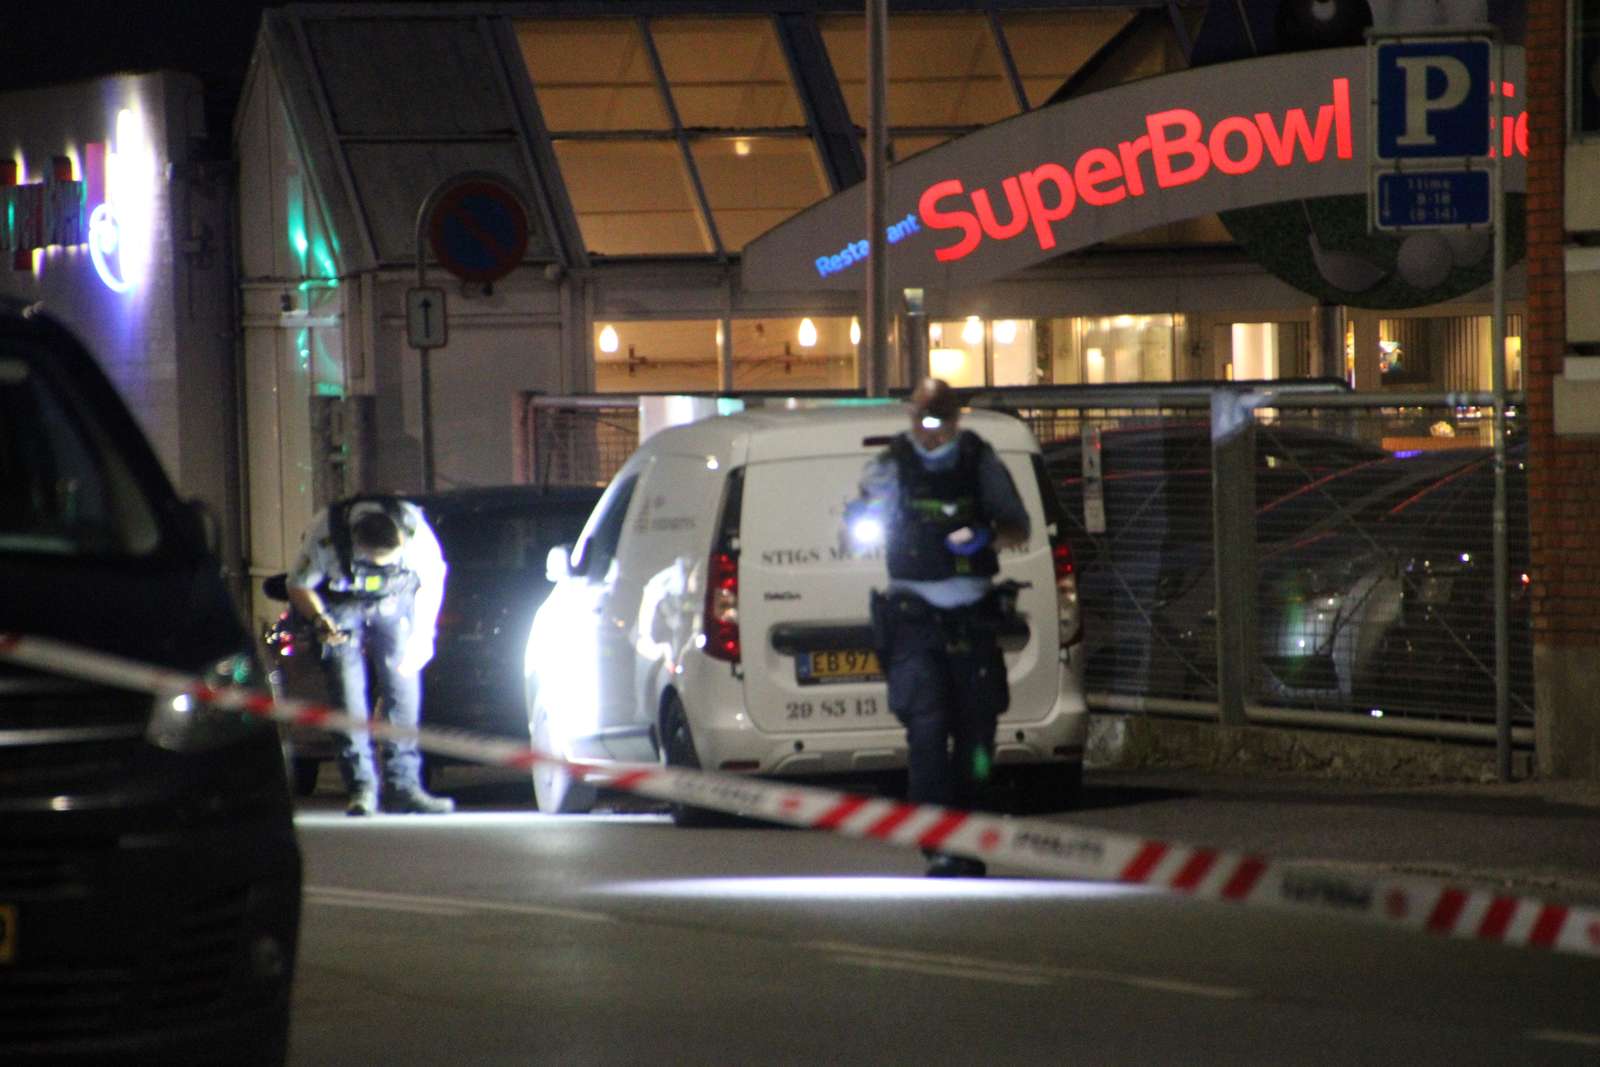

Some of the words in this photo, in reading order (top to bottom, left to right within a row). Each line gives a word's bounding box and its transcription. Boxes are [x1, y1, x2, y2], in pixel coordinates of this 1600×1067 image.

[1396, 56, 1471, 146] P
[816, 213, 921, 278] Restaant
[918, 77, 1353, 262] SuperBowl
[762, 548, 820, 566] STIGS
[813, 651, 839, 673] EB
